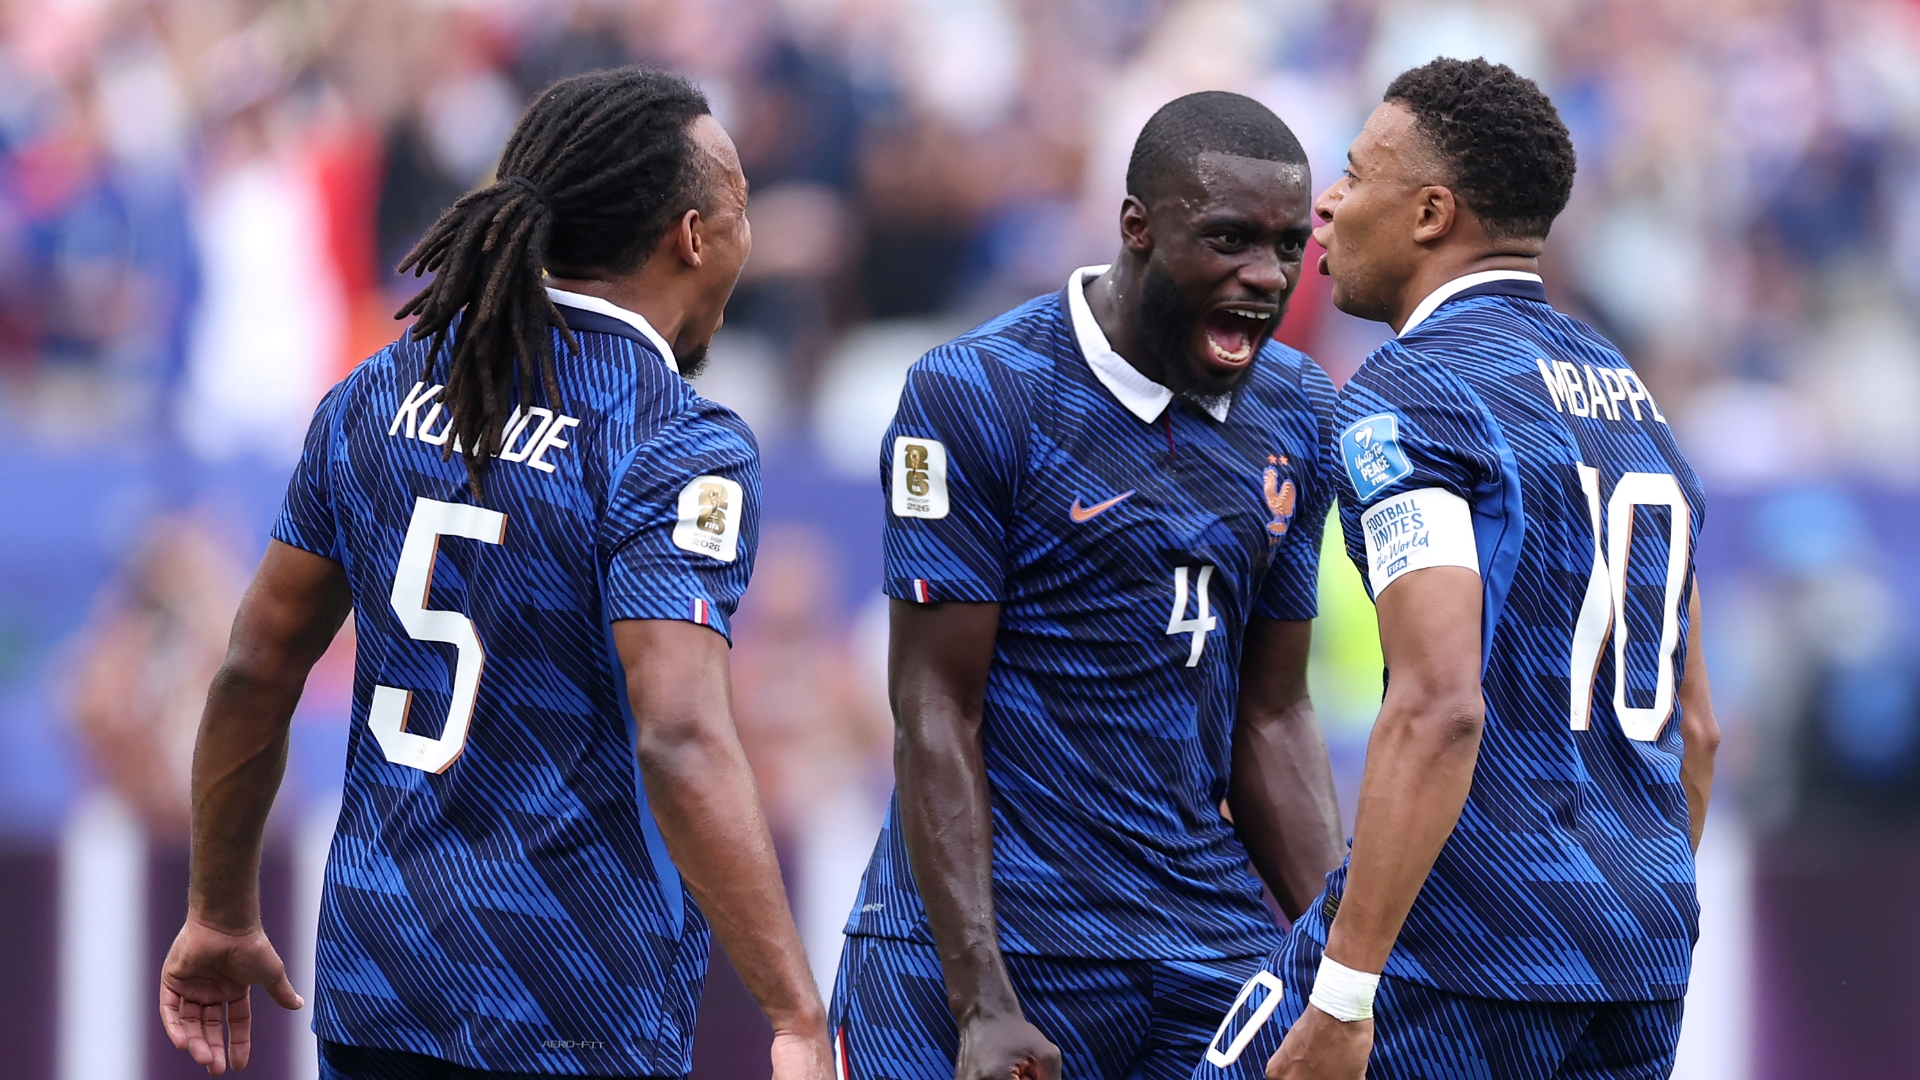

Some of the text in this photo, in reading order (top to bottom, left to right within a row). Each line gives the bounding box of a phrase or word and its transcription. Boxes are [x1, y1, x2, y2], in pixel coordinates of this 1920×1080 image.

[388, 381, 580, 473] KODE
[1361, 455, 1390, 482] PEACE
[1371, 472, 1389, 486] FIFA
[906, 503, 930, 512] 2026
[1366, 499, 1420, 534] FOOTBALL
[704, 521, 720, 531] FIFA
[1373, 513, 1424, 552] UNITES
[692, 538, 721, 552] 2026
[1376, 531, 1430, 571] the World
[1387, 556, 1408, 578] FIFA
[1570, 460, 1690, 741] 10
[1165, 565, 1217, 668] 4
[367, 496, 508, 774] 5
[541, 1040, 606, 1050] AERO-FIT
